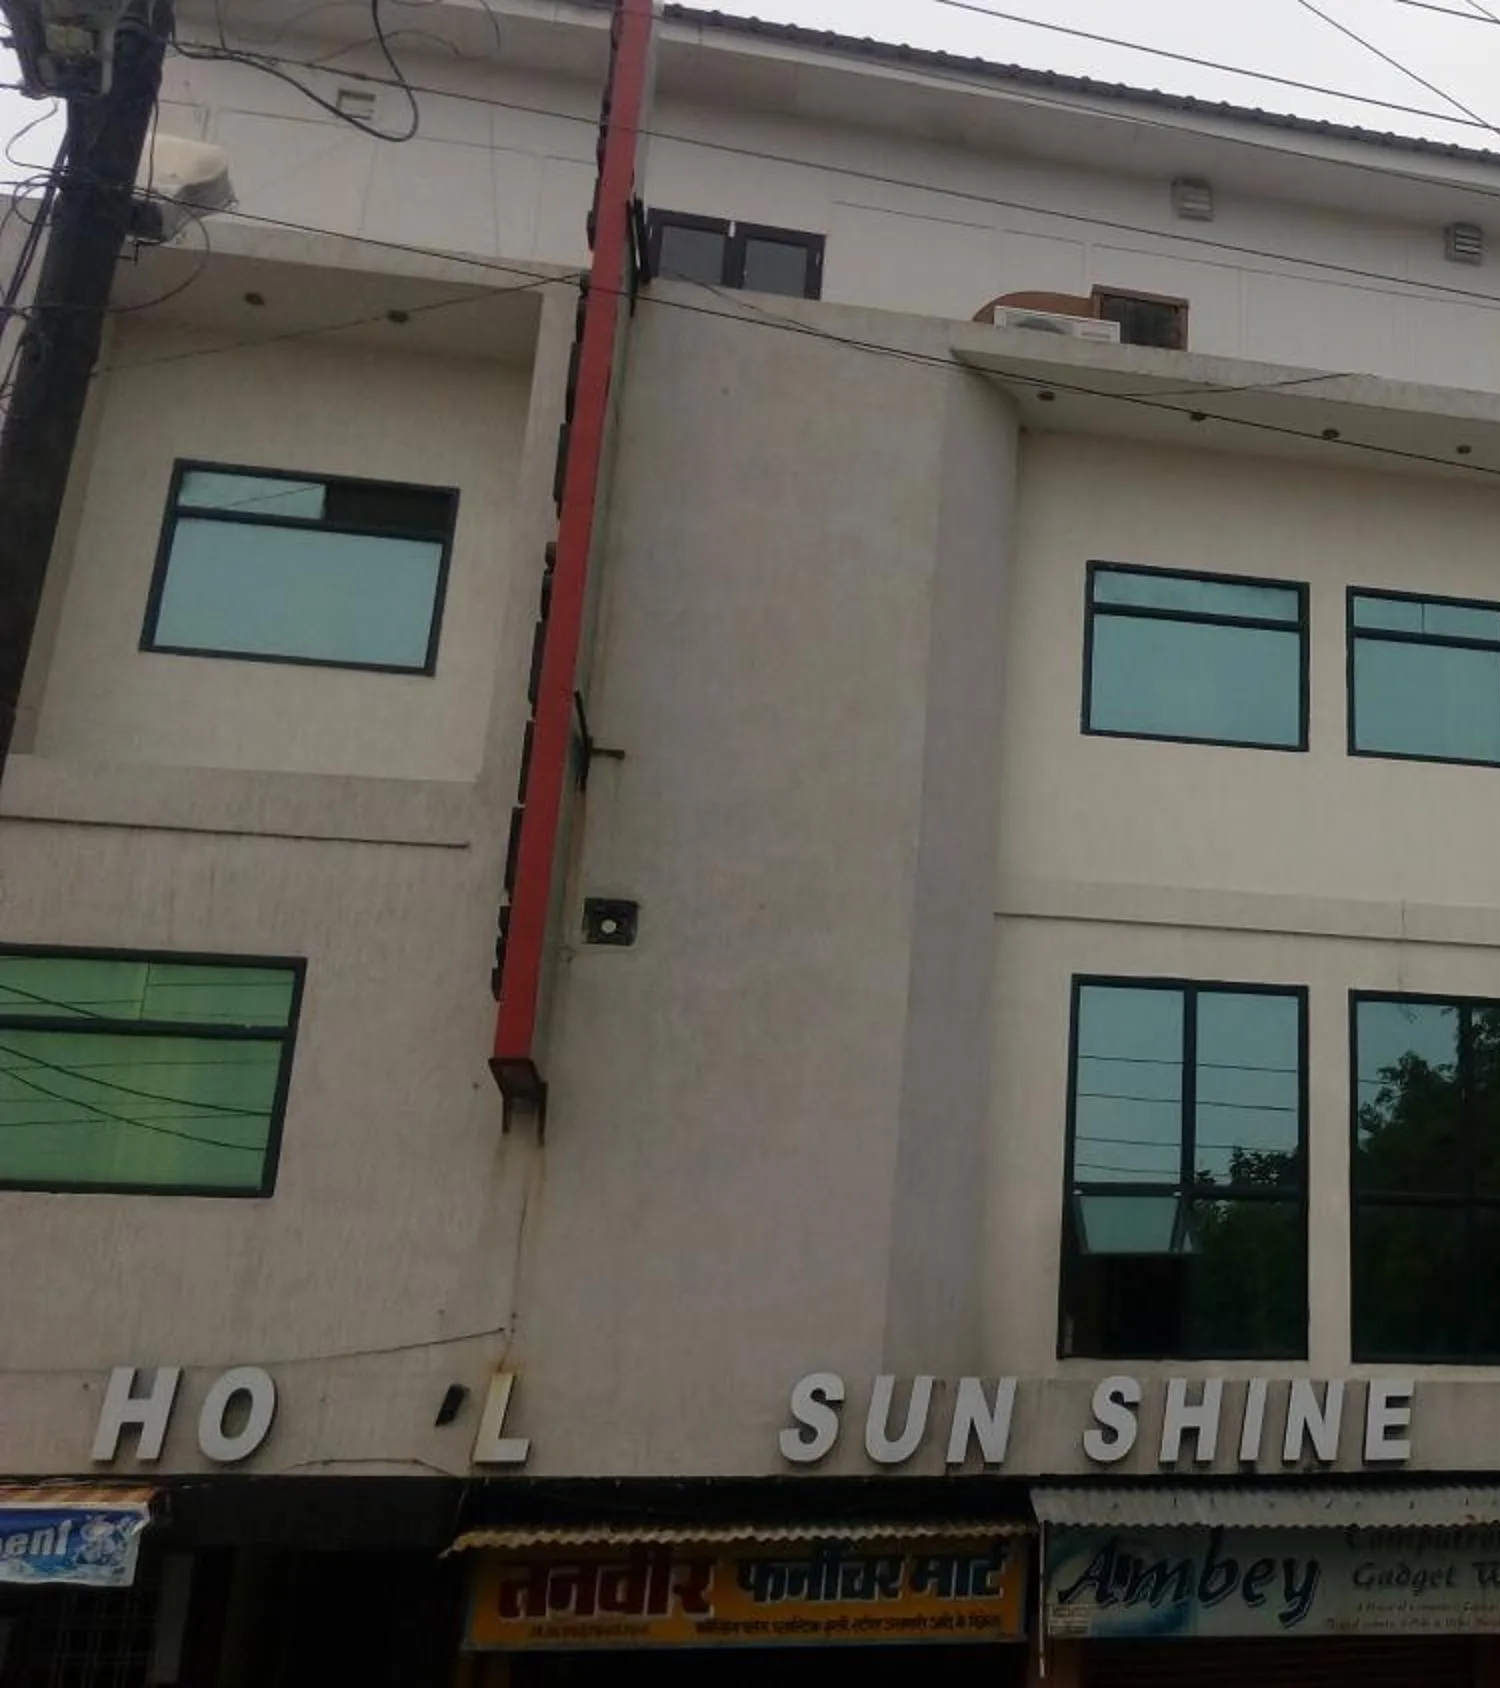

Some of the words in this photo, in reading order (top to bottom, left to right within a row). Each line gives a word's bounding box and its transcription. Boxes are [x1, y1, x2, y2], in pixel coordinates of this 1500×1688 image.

[780, 1372, 1018, 1463] SUN
[1083, 1375, 1415, 1462] SHINE
[0, 1518, 73, 1557] ent
[497, 1543, 717, 1619] तनवीर
[1057, 1525, 1321, 1629] Ambey
[1351, 1560, 1459, 1597] Gadget
